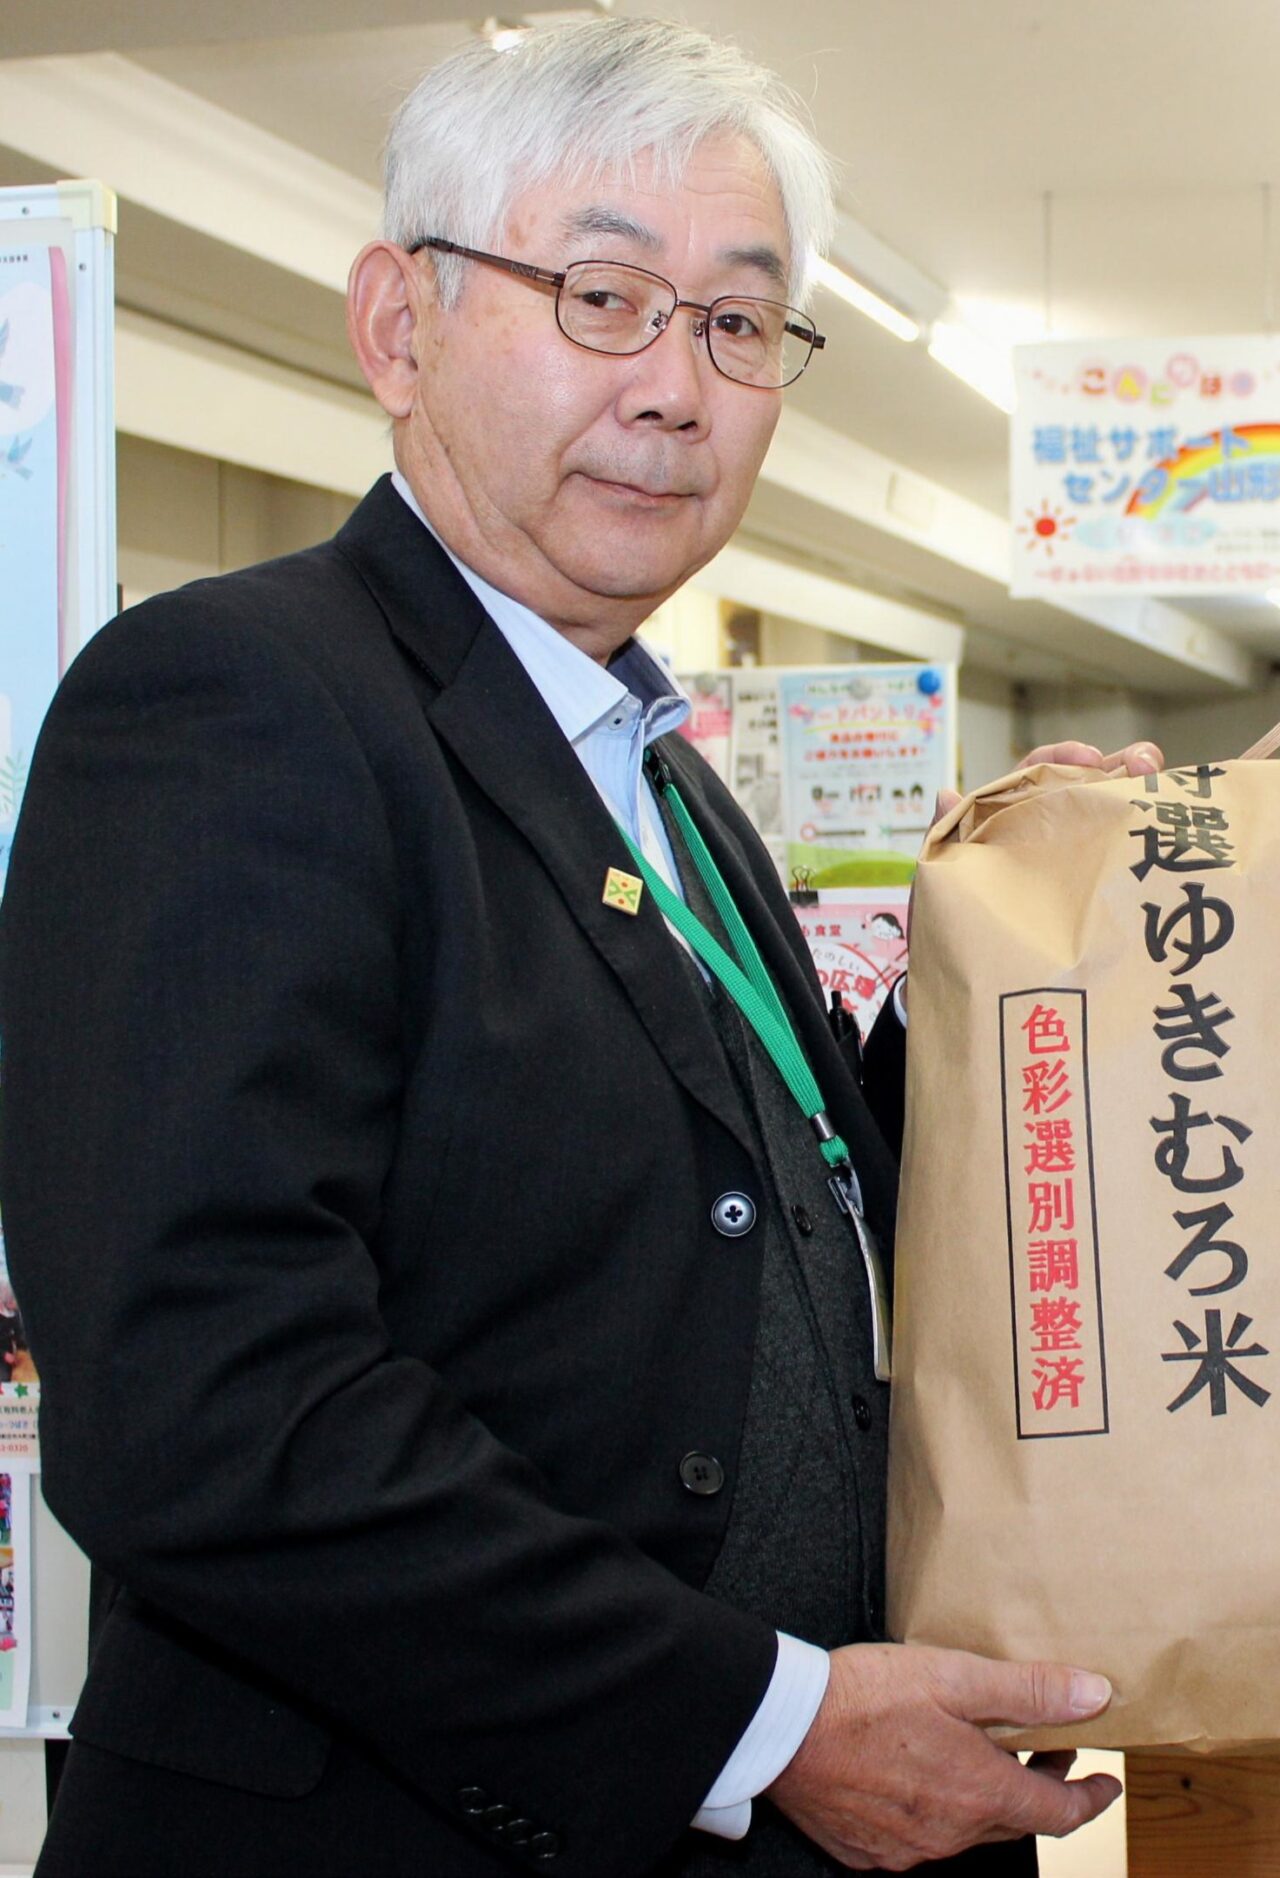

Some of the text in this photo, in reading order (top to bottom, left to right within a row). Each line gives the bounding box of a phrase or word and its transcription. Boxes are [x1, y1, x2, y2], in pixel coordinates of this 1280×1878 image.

[1034, 424, 1250, 463] 福祉サポート
[1022, 1004, 1084, 1410] 色彩選別調整済
